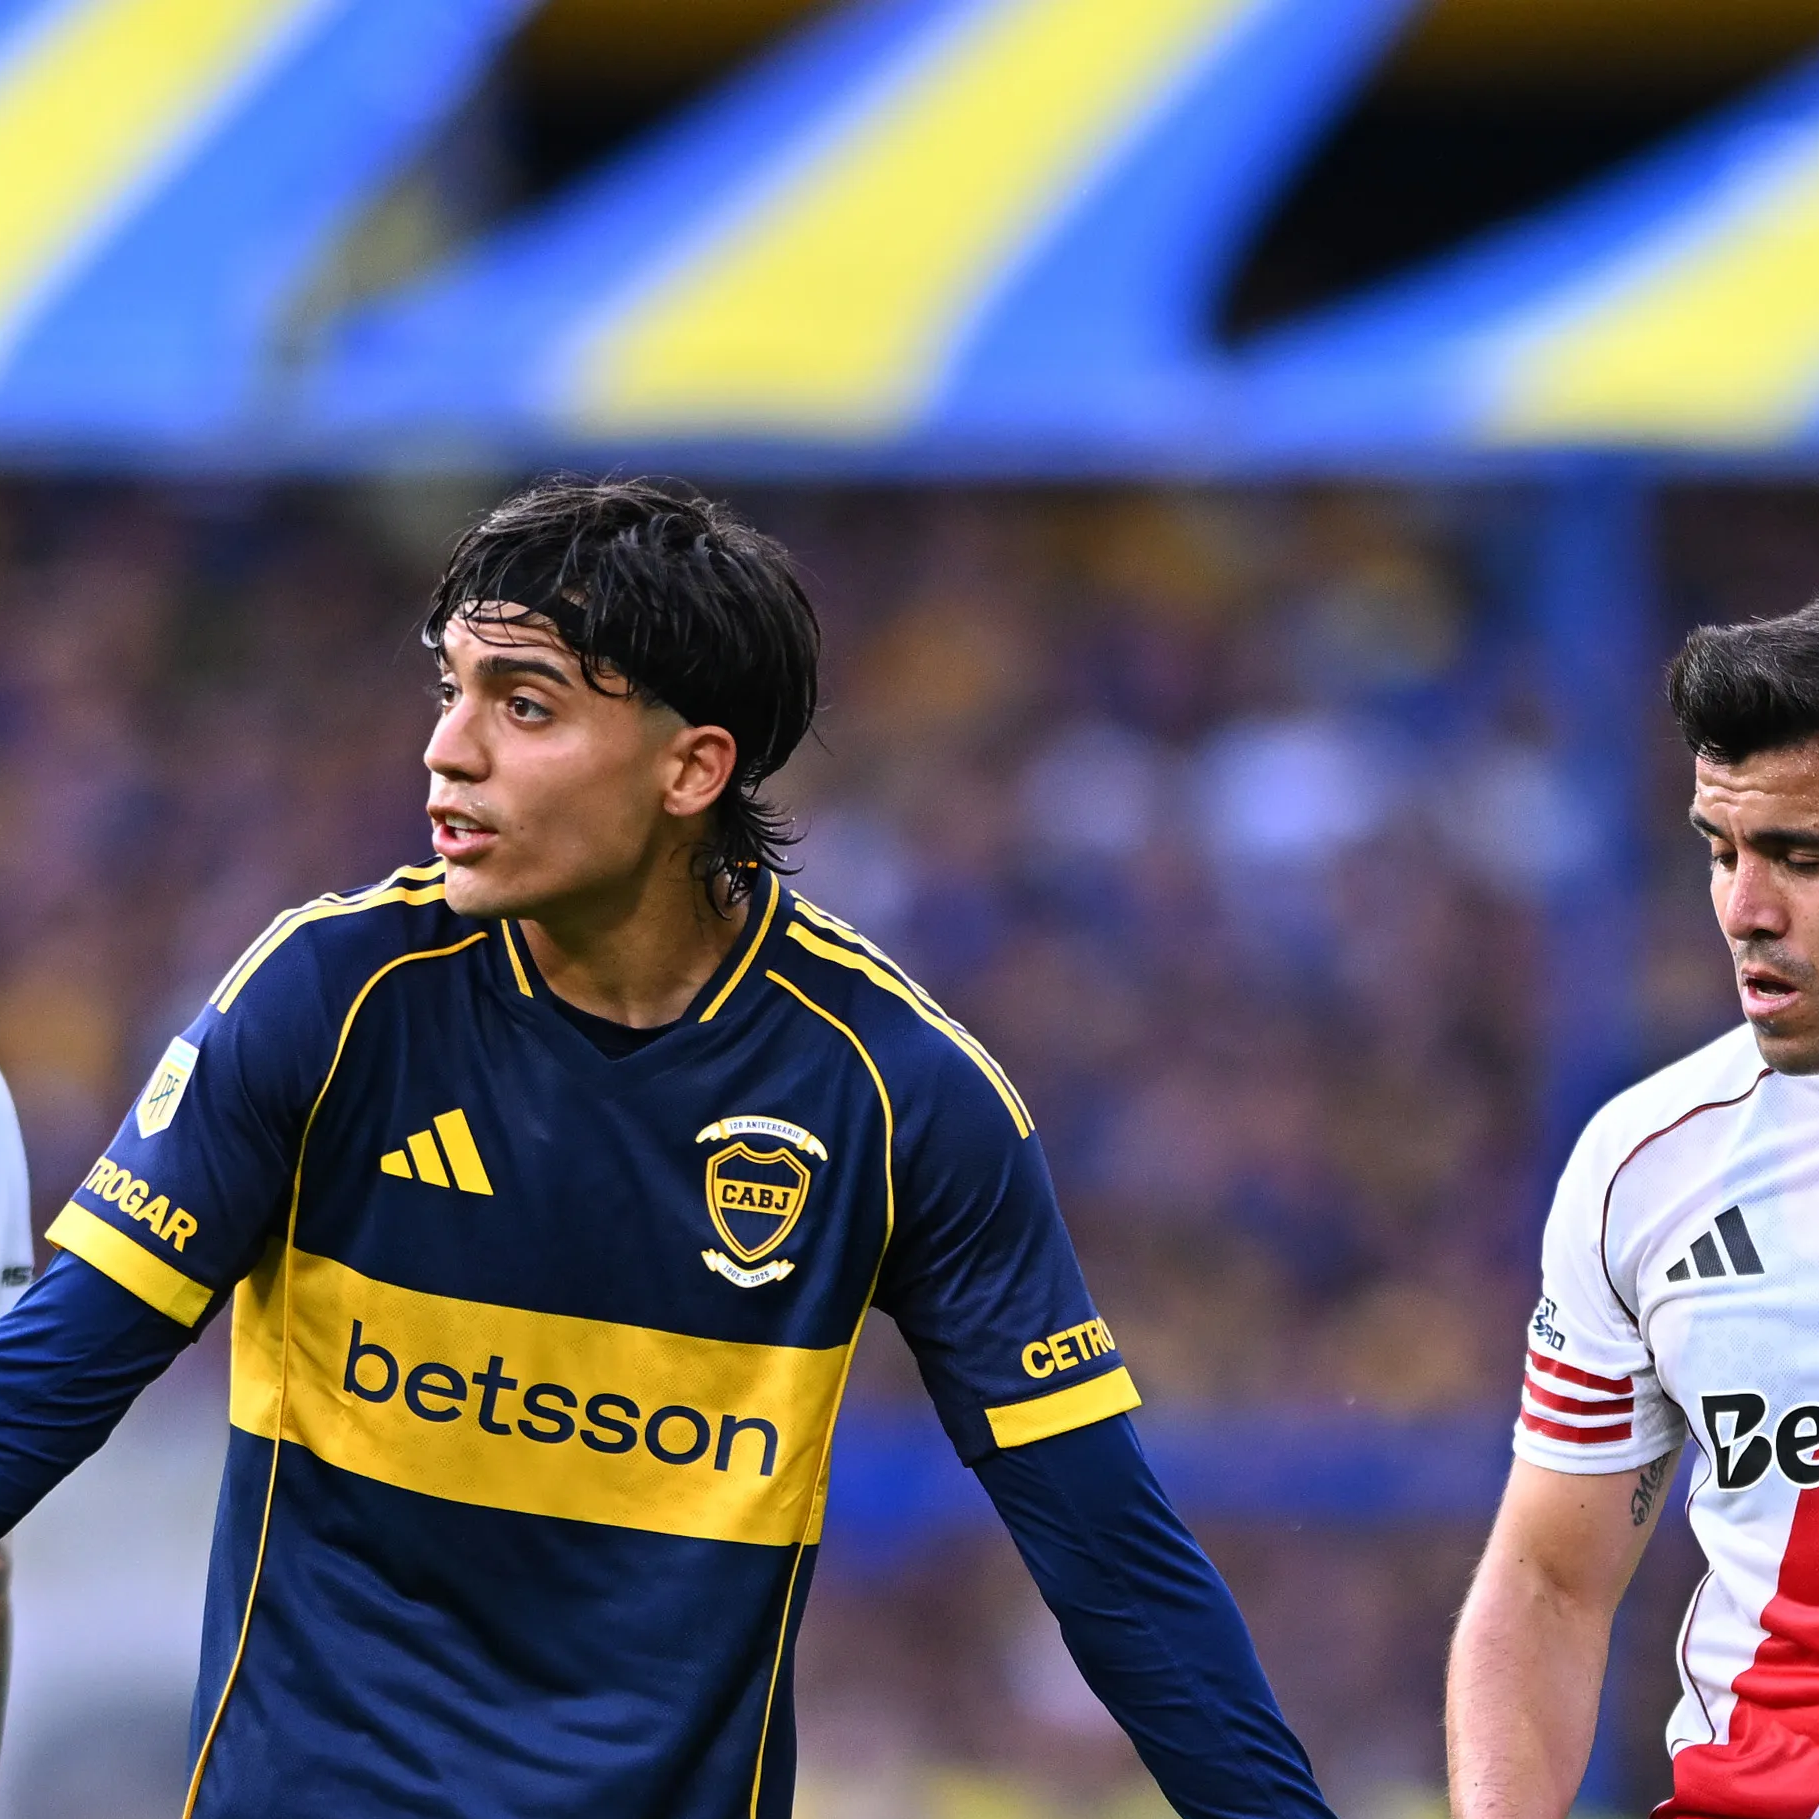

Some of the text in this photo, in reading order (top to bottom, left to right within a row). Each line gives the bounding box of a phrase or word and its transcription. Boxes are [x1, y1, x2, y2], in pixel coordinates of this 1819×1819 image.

[746, 1121, 801, 1139] ANIVERSARIO
[722, 1184, 790, 1210] CABJ
[344, 1319, 779, 1476] betsson
